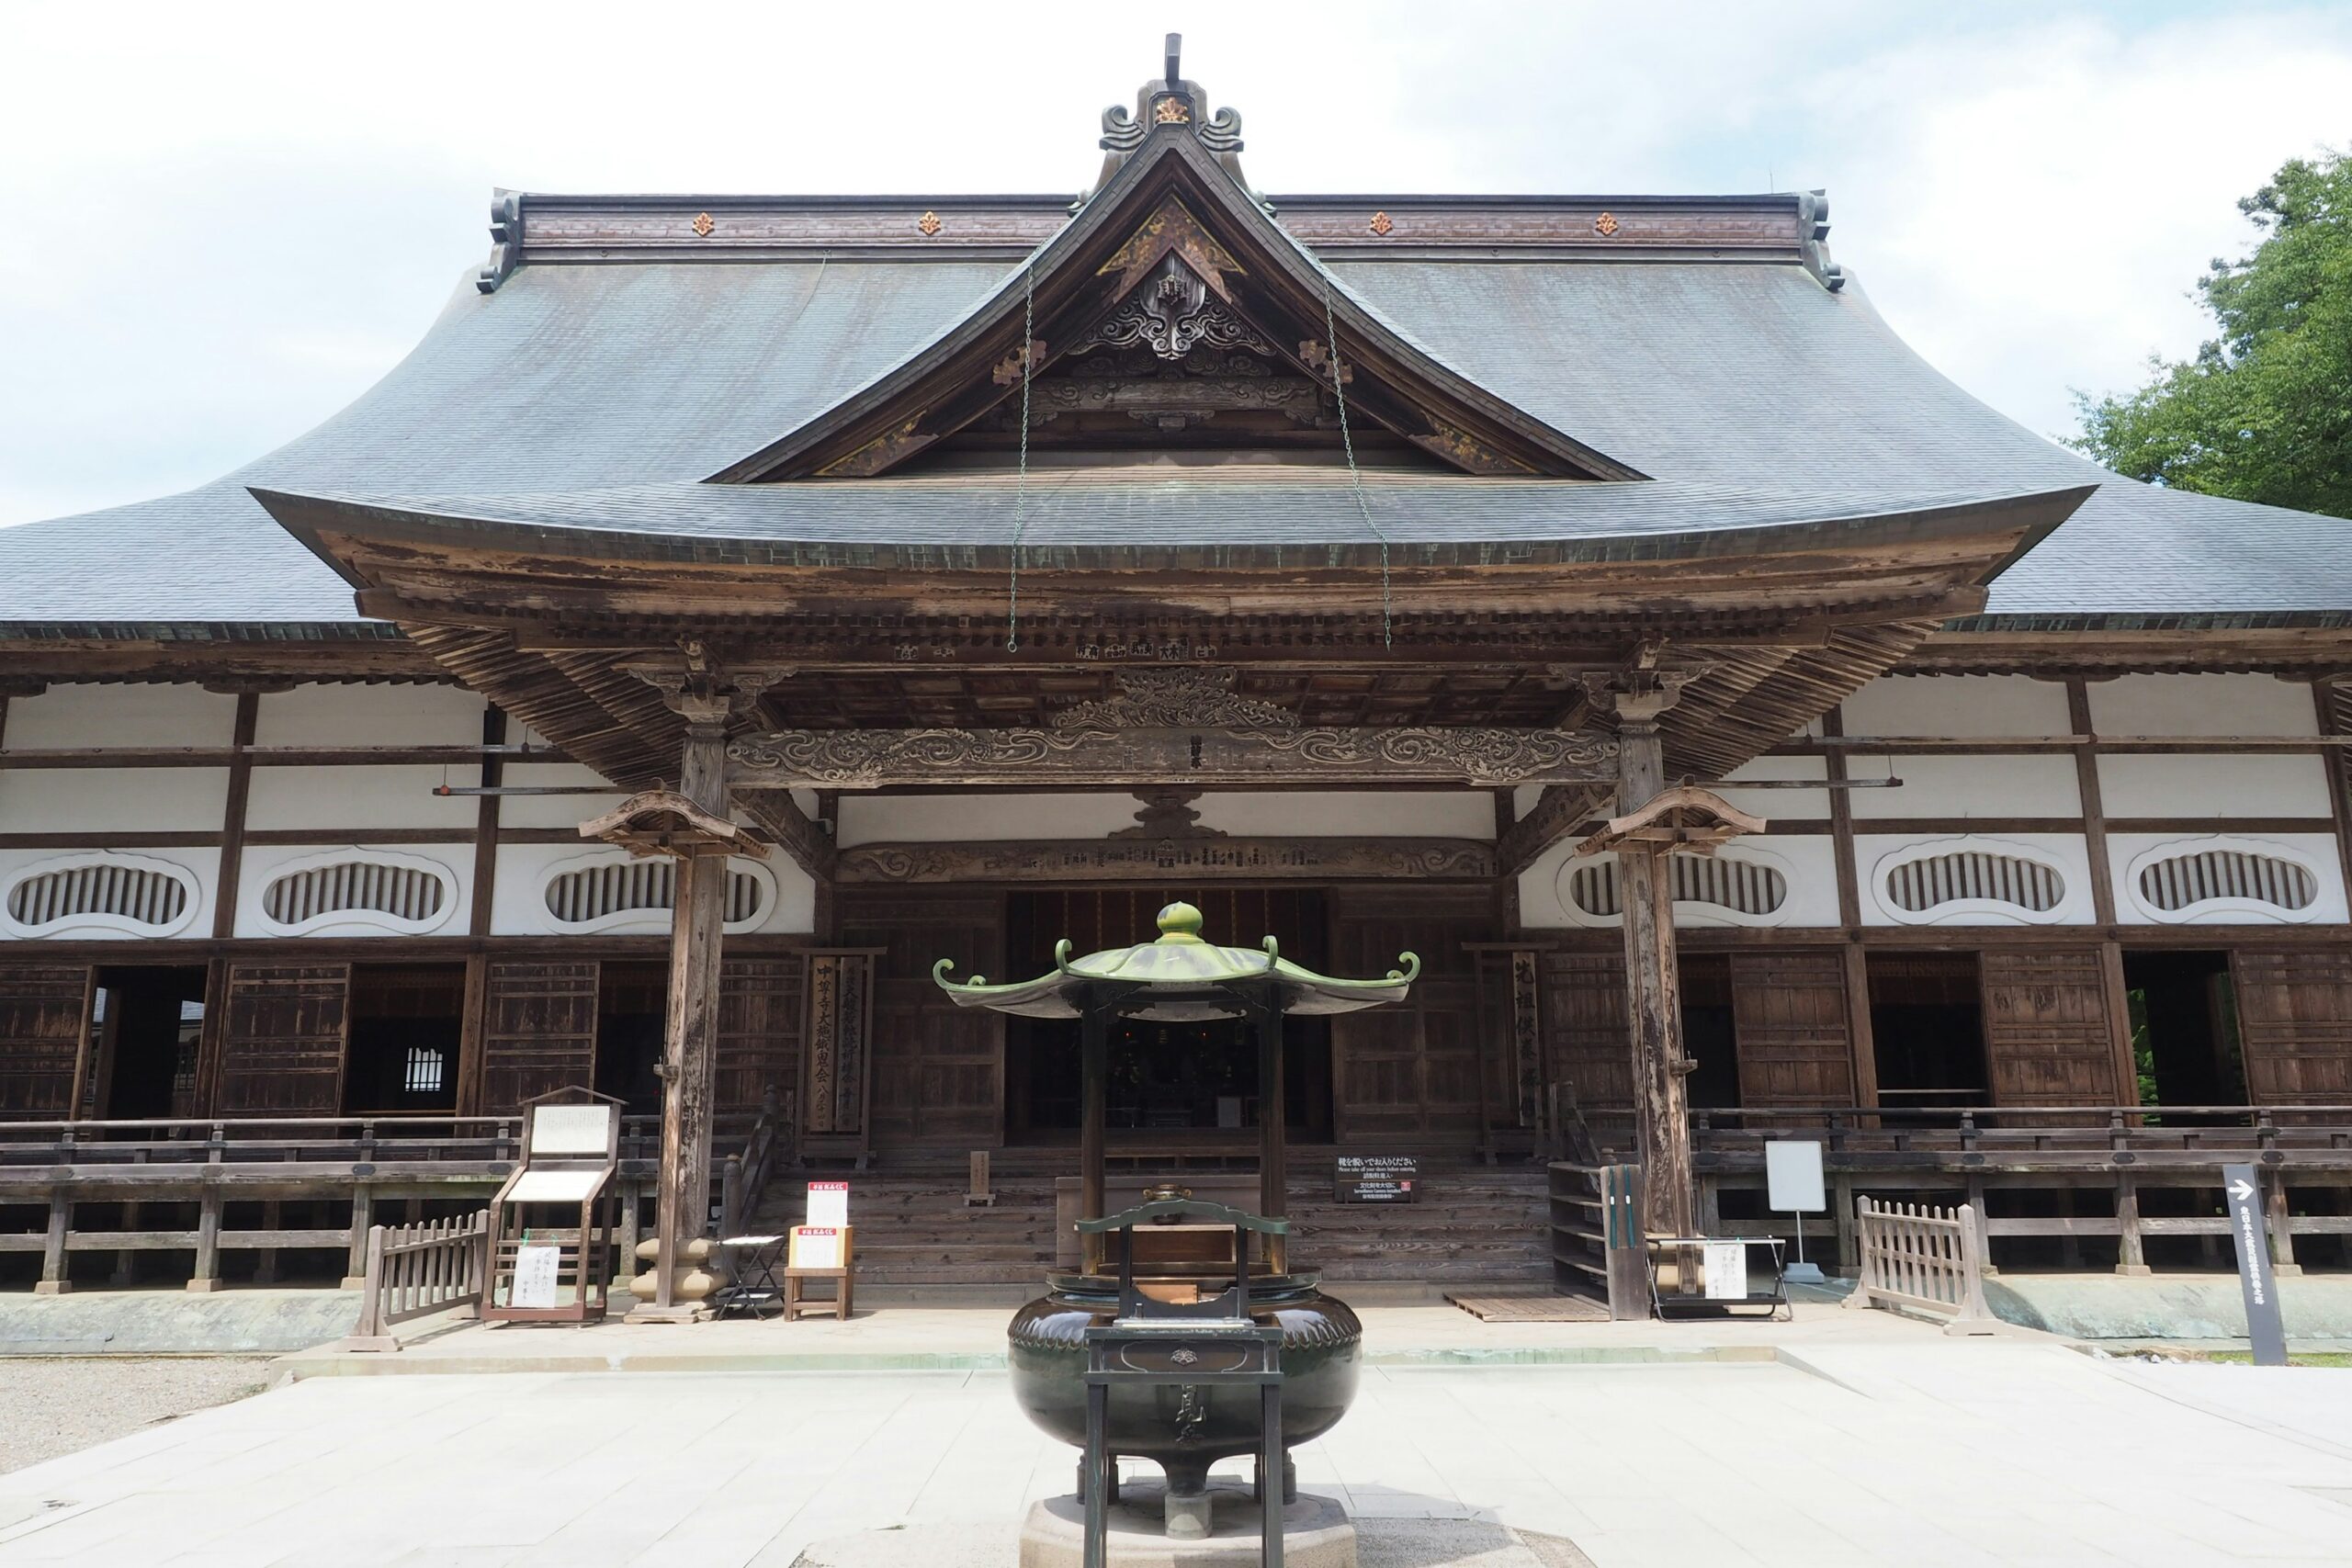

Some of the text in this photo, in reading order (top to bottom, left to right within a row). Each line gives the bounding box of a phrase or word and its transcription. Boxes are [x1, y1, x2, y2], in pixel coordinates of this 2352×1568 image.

[1338, 1156, 1417, 1167] 靴を脱いでお入りください
